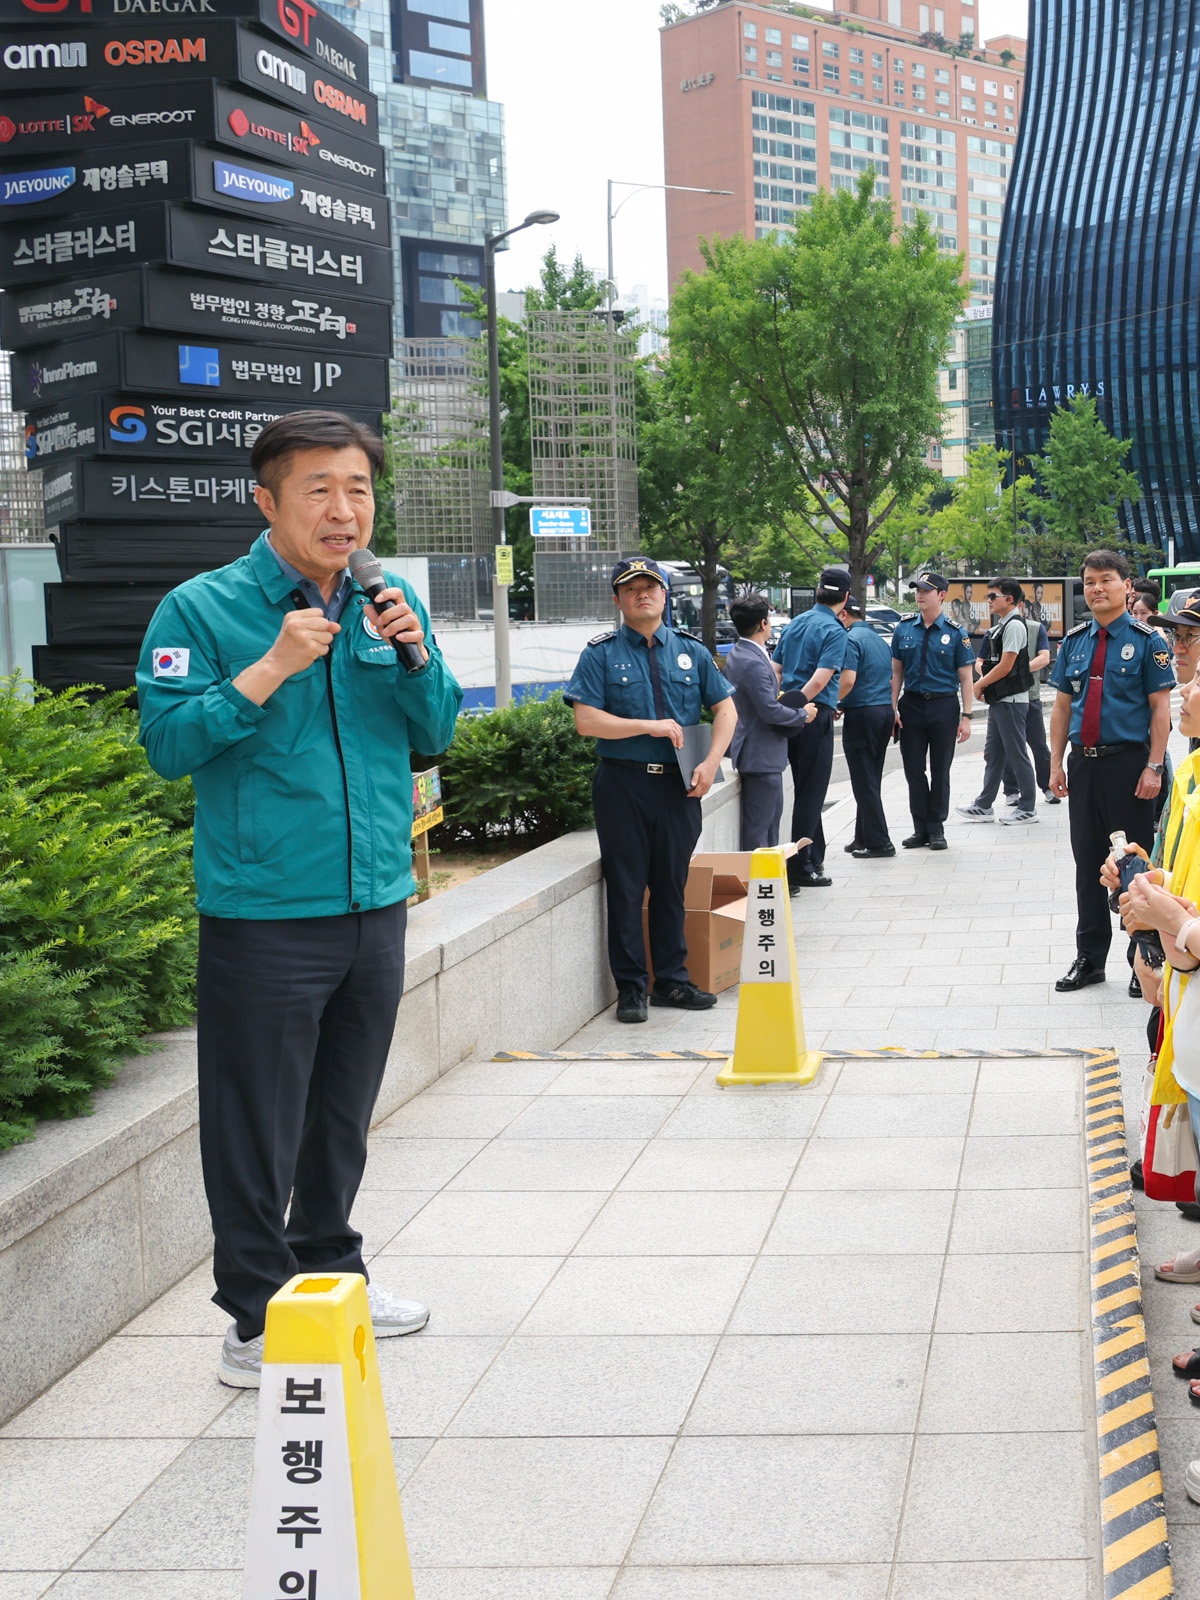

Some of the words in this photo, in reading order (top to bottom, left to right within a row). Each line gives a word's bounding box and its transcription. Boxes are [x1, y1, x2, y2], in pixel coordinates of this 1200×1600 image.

[104, 38, 206, 66] OSRAM
[316, 38, 357, 80] DAEGAK
[313, 80, 367, 125] OSRAM
[19, 120, 65, 134] LOTTE
[72, 114, 95, 132] SK
[109, 110, 196, 126] ENEROOT
[251, 122, 287, 147] LOTTE
[292, 136, 311, 156] SK
[318, 149, 377, 178] ENEROOT
[4, 175, 71, 199] JAEYOUNG
[83, 160, 169, 192] 재영솔루텍
[223, 170, 291, 200] JAEYOUNG
[300, 188, 376, 230] 재영솔루텍
[13, 221, 136, 266] 스타클러스터
[208, 228, 363, 284] 스타클러스터
[190, 292, 250, 318] 법무법인
[254, 302, 285, 320] 정향
[231, 360, 302, 385] 법무법인
[312, 362, 342, 393] JP
[151, 405, 177, 416] Your
[180, 407, 205, 418] Best
[208, 409, 242, 420] Credit
[757, 884, 775, 977] 보행주의
